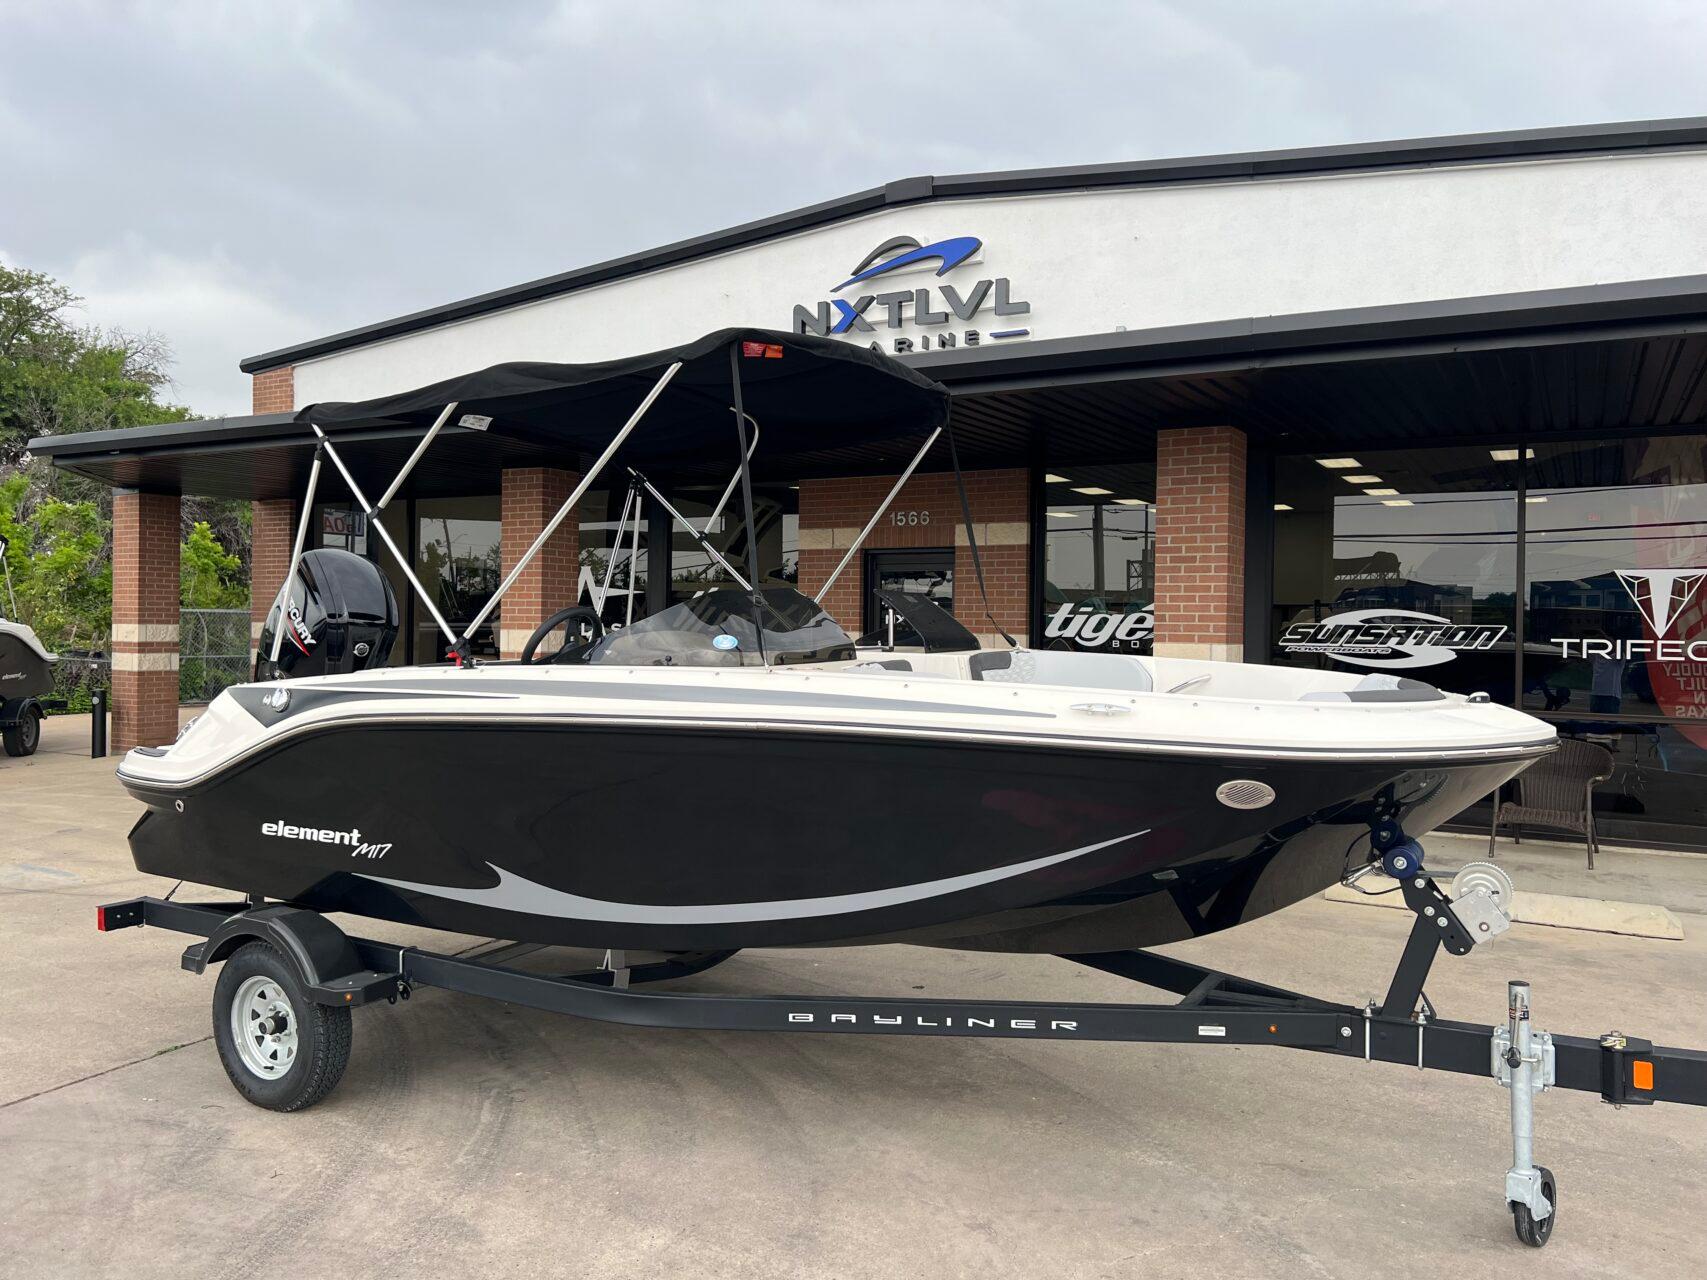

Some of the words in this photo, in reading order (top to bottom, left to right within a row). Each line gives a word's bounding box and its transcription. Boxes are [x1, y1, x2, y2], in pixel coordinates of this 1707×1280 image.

[793, 277, 1031, 337] NXTLVL
[869, 329, 980, 354] ARINE
[890, 510, 930, 526] 1566
[287, 595, 317, 645] RCURY
[1279, 623, 1508, 649] SUNSATION
[1285, 645, 1392, 654] POWERBOATS
[261, 820, 361, 846] element
[351, 842, 392, 858] M17
[788, 1013, 1078, 1031] BAYLINER
